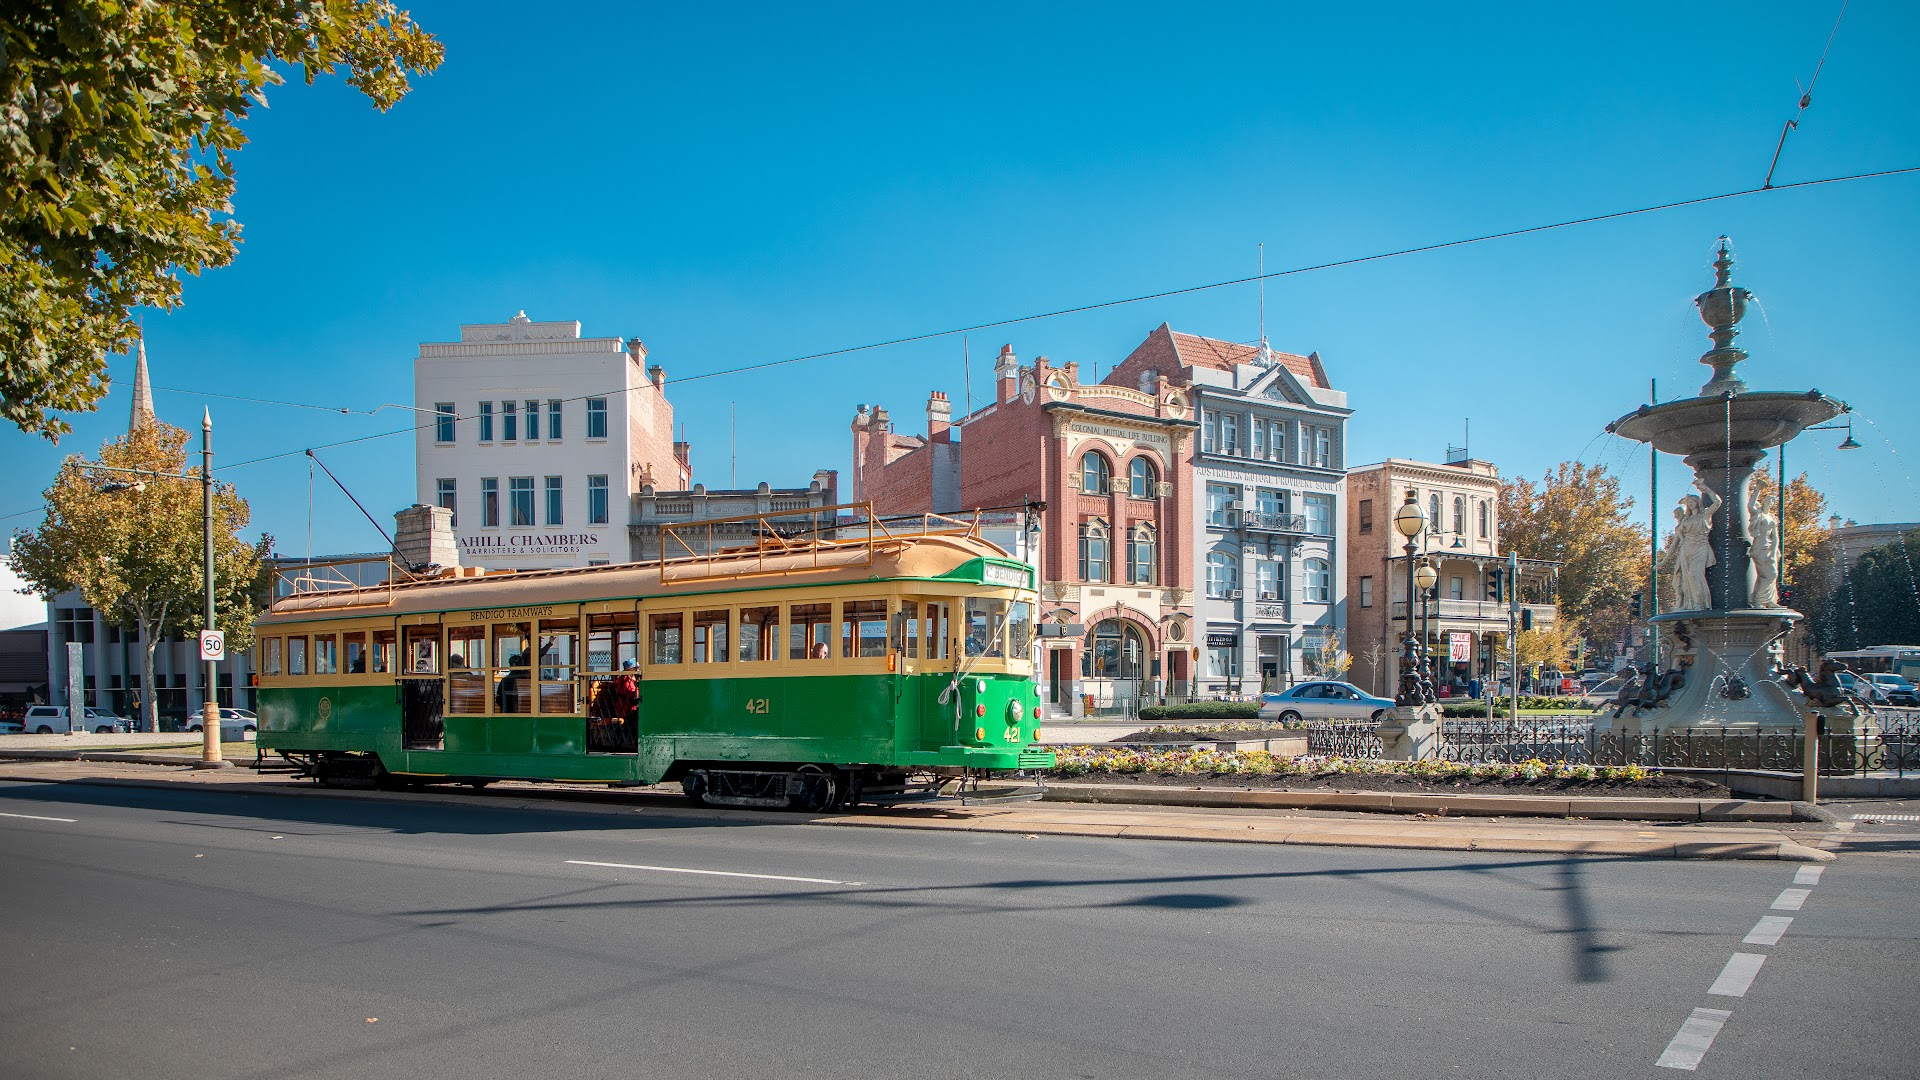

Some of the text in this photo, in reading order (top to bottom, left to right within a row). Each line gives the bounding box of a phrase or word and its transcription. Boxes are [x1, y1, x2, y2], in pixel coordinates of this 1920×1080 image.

[1071, 423, 1168, 444] COLONIAL MUTUAL LIFE BUILDING
[1196, 466, 1343, 492] AUSTRALIAN MUTUAL PROVIDENT SOCIETY
[455, 533, 599, 549] AHILL CHAMBERS
[466, 546, 580, 555] BARRISTERS & SOLICITORS
[994, 565, 1027, 584] BENDIGO
[470, 606, 553, 621] BENDIGO TRAMWAYS
[205, 639, 221, 651] 50
[745, 698, 770, 714] 421
[1003, 726, 1021, 743] 421
